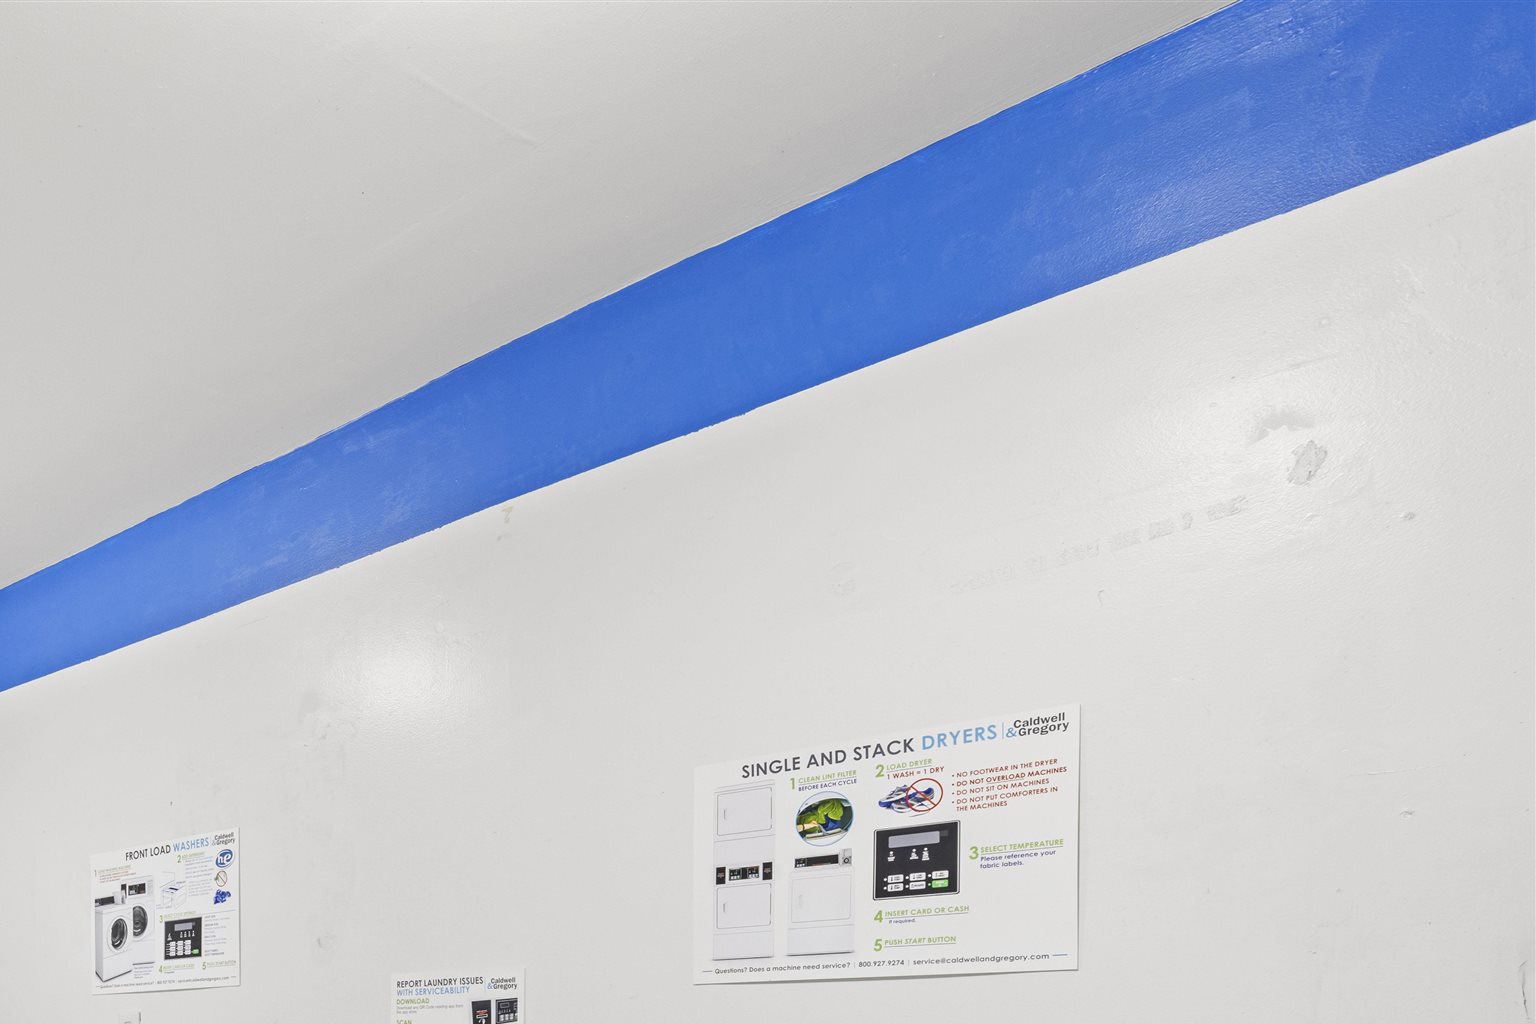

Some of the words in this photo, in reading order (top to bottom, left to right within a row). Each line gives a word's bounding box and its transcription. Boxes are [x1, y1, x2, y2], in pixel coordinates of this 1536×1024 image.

[1014, 712, 1065, 728] Caldwell
[1006, 727, 1017, 738] &
[1018, 722, 1069, 736] Gregory
[741, 757, 801, 779] SINGLE
[807, 750, 847, 768] AND
[853, 737, 914, 761] STACK
[922, 724, 997, 750] DRYERS
[875, 764, 884, 778] 2
[887, 762, 907, 770] LOAD
[909, 758, 932, 767] DRYER
[930, 766, 944, 774] DRY
[970, 766, 1009, 776] FOOTWEAR
[1035, 759, 1058, 767] DRYER
[790, 778, 795, 790] 1
[798, 775, 820, 784] CLEAN
[822, 773, 836, 781] LINT
[837, 770, 856, 778] FILTER
[986, 772, 1025, 782] OVERLOAD
[1028, 766, 1067, 777] MACHINES
[838, 779, 857, 787] CYCLE
[1011, 778, 1049, 789] MACHINES
[1000, 788, 1048, 799] COMFORTERS
[970, 801, 1008, 810] MACHINES
[214, 832, 234, 840] Caldwell
[217, 838, 235, 846] Gregory
[125, 848, 148, 861] FRONT
[150, 845, 171, 856] LOAD
[173, 837, 209, 851] WASHERS
[969, 846, 979, 860] 3
[980, 844, 1007, 853] SELECT
[1009, 839, 1064, 850] TEMPERATURE
[1004, 852, 1038, 860] reference
[874, 910, 883, 922] 4
[874, 939, 882, 952] 5
[397, 980, 422, 988] REPORT
[424, 978, 457, 987] LAUNDRY
[459, 977, 483, 985] ISSUES
[415, 986, 470, 996] SERVICEABILITY
